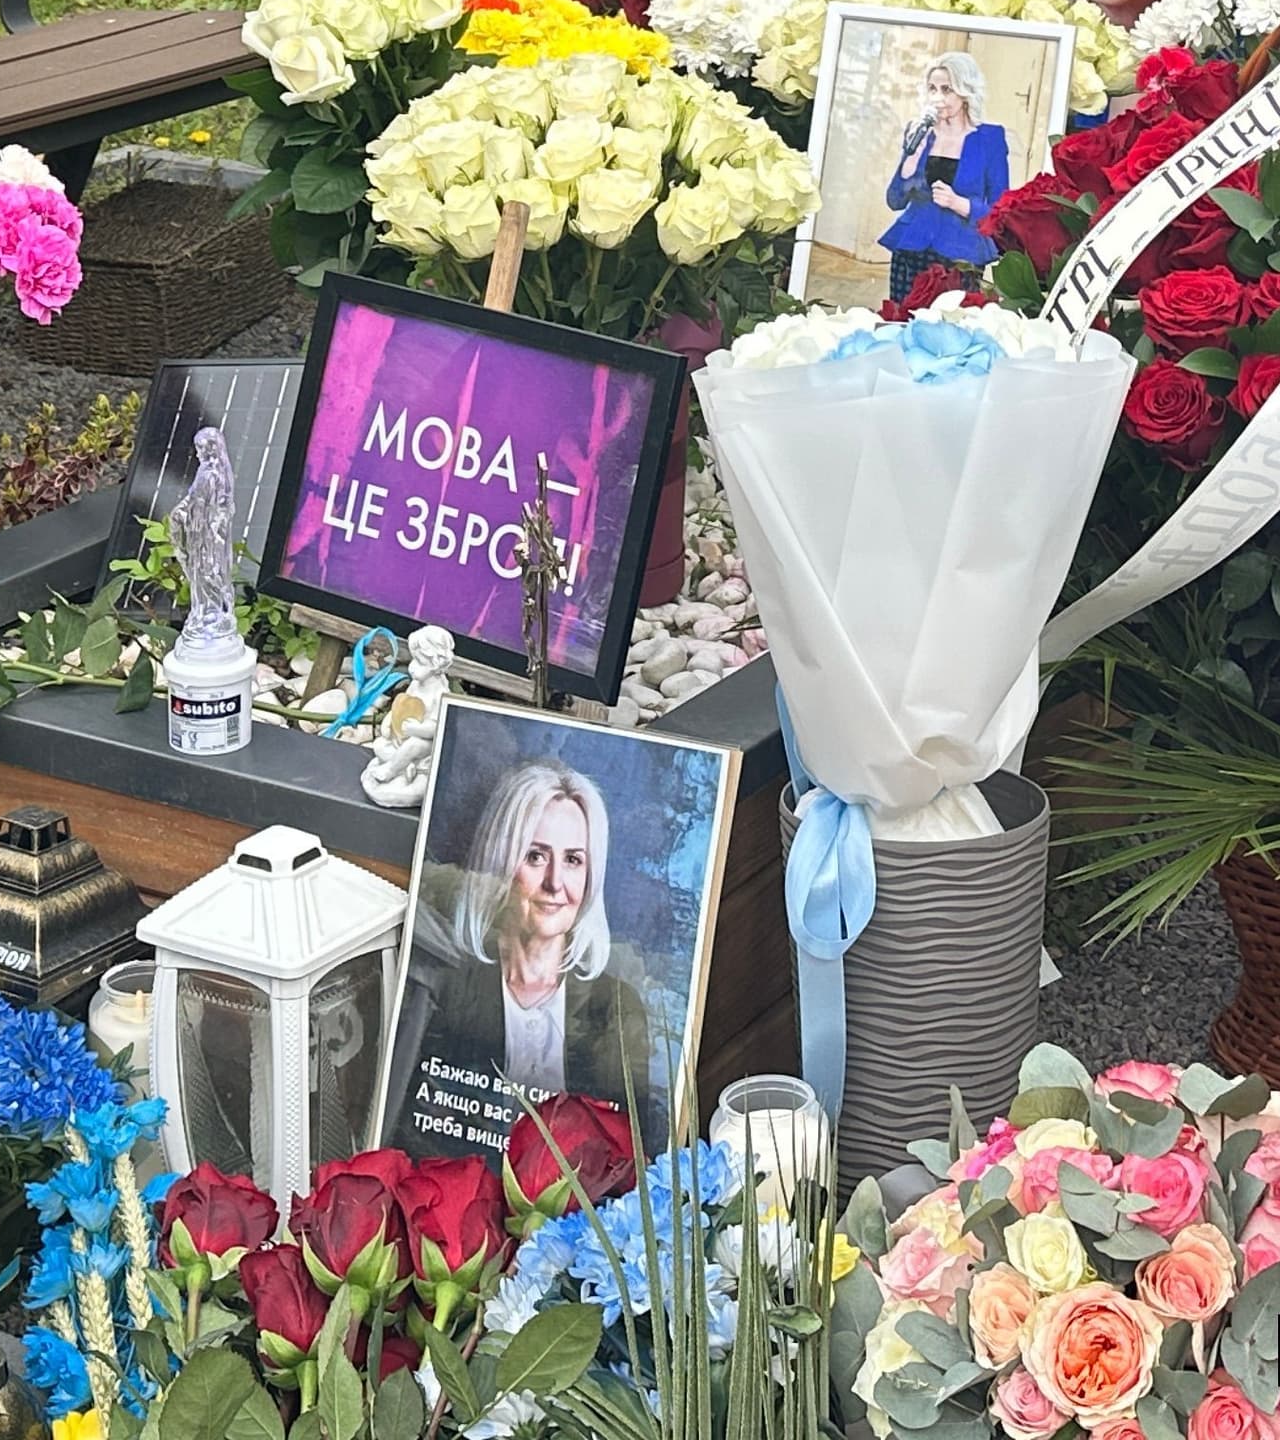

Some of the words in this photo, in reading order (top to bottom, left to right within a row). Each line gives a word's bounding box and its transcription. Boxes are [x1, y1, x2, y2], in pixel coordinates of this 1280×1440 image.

[1045, 239, 1122, 335] ТРІ
[362, 400, 518, 493] МОВА
[322, 473, 389, 543] ЦЕ
[183, 701, 236, 716] subito
[421, 1056, 490, 1089] «Бажаю
[493, 1076, 525, 1097] вам
[415, 1081, 430, 1103] А
[433, 1090, 481, 1117] якщо
[484, 1106, 512, 1123] вас
[413, 1111, 463, 1138] треба
